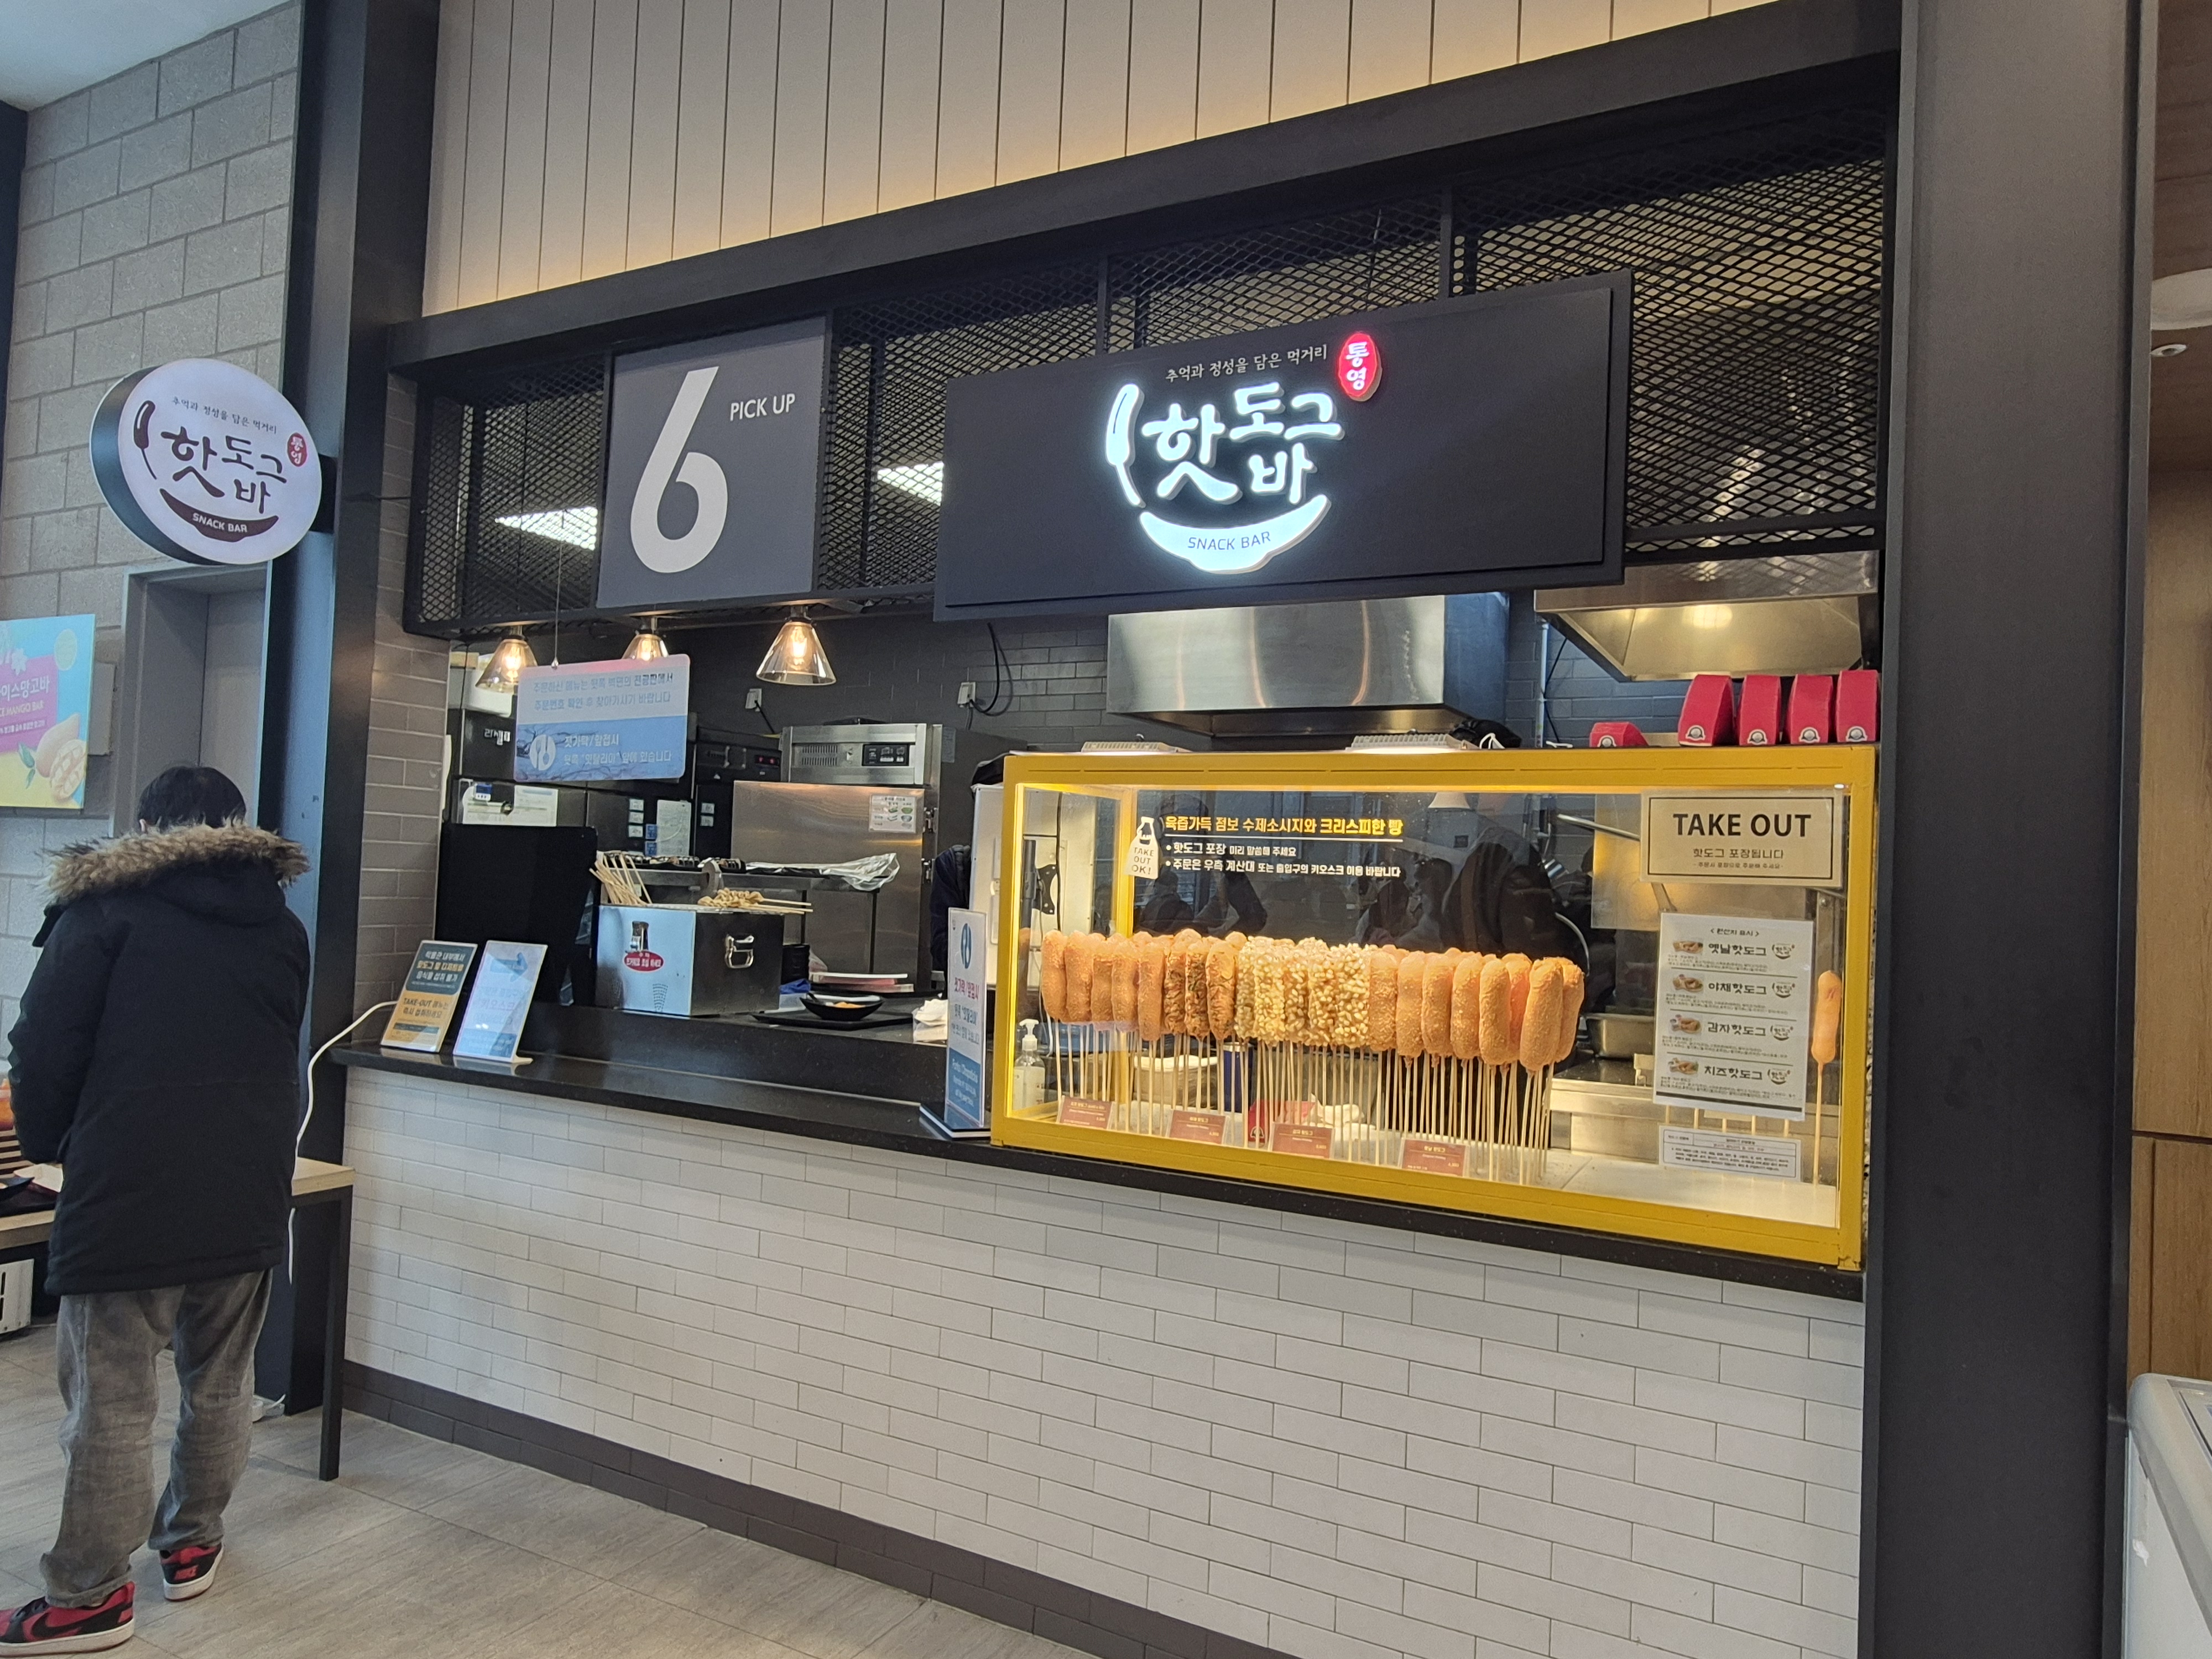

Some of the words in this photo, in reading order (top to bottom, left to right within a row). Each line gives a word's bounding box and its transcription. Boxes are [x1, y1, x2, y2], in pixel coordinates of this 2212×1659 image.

[1165, 363, 1205, 383] 추억과
[1209, 357, 1249, 377] 정성을
[1254, 352, 1282, 371] 담은
[1287, 344, 1327, 365] 먹거리
[1345, 341, 1370, 391] 통영
[172, 396, 198, 411] 추억과
[203, 405, 229, 421] 정성을
[232, 413, 250, 427] 담은
[253, 420, 277, 435] 먹거리
[729, 397, 768, 422] PICK
[773, 393, 796, 413] UP
[1141, 381, 1345, 504] 핫도그
[160, 425, 287, 498] 핫도그
[630, 366, 728, 573] 6
[1248, 442, 1318, 505] 바
[233, 478, 272, 514] 바
[192, 512, 225, 532] SNACK
[227, 521, 248, 534] BAR
[1187, 535, 1235, 551] SNACK
[1240, 530, 1271, 549] BAR
[0, 675, 50, 701] 이스망고바
[1165, 816, 1212, 831] 육즙가득
[1215, 816, 1239, 832] 점보
[1243, 818, 1317, 833] 수제소시지와
[1320, 818, 1386, 835] 크리스피한
[1672, 813, 1742, 837] TAKE
[1750, 813, 1812, 838] OUT
[1134, 847, 1155, 857] TAKE
[1134, 855, 1151, 864] OUT
[1173, 842, 1203, 854] 핫도그
[1206, 842, 1227, 855] 포장
[1229, 845, 1245, 855] 미리
[1272, 847, 1297, 857] 주세요
[1693, 848, 1725, 858] 핫도그
[1729, 848, 1784, 859] 포장됩니다
[1131, 864, 1151, 875] OK!
[1173, 858, 1201, 871] 주문은
[1204, 859, 1223, 872] 우측
[1258, 862, 1274, 873] 또는
[1311, 864, 1344, 875] 키오스크
[1365, 865, 1401, 878] 바랍니다
[1708, 943, 1767, 956] 옛날핫도그
[1708, 982, 1767, 995] 야채핫도그
[1707, 1022, 1766, 1037] 감자핫도그
[1704, 1066, 1763, 1080] 치즈핫도그
